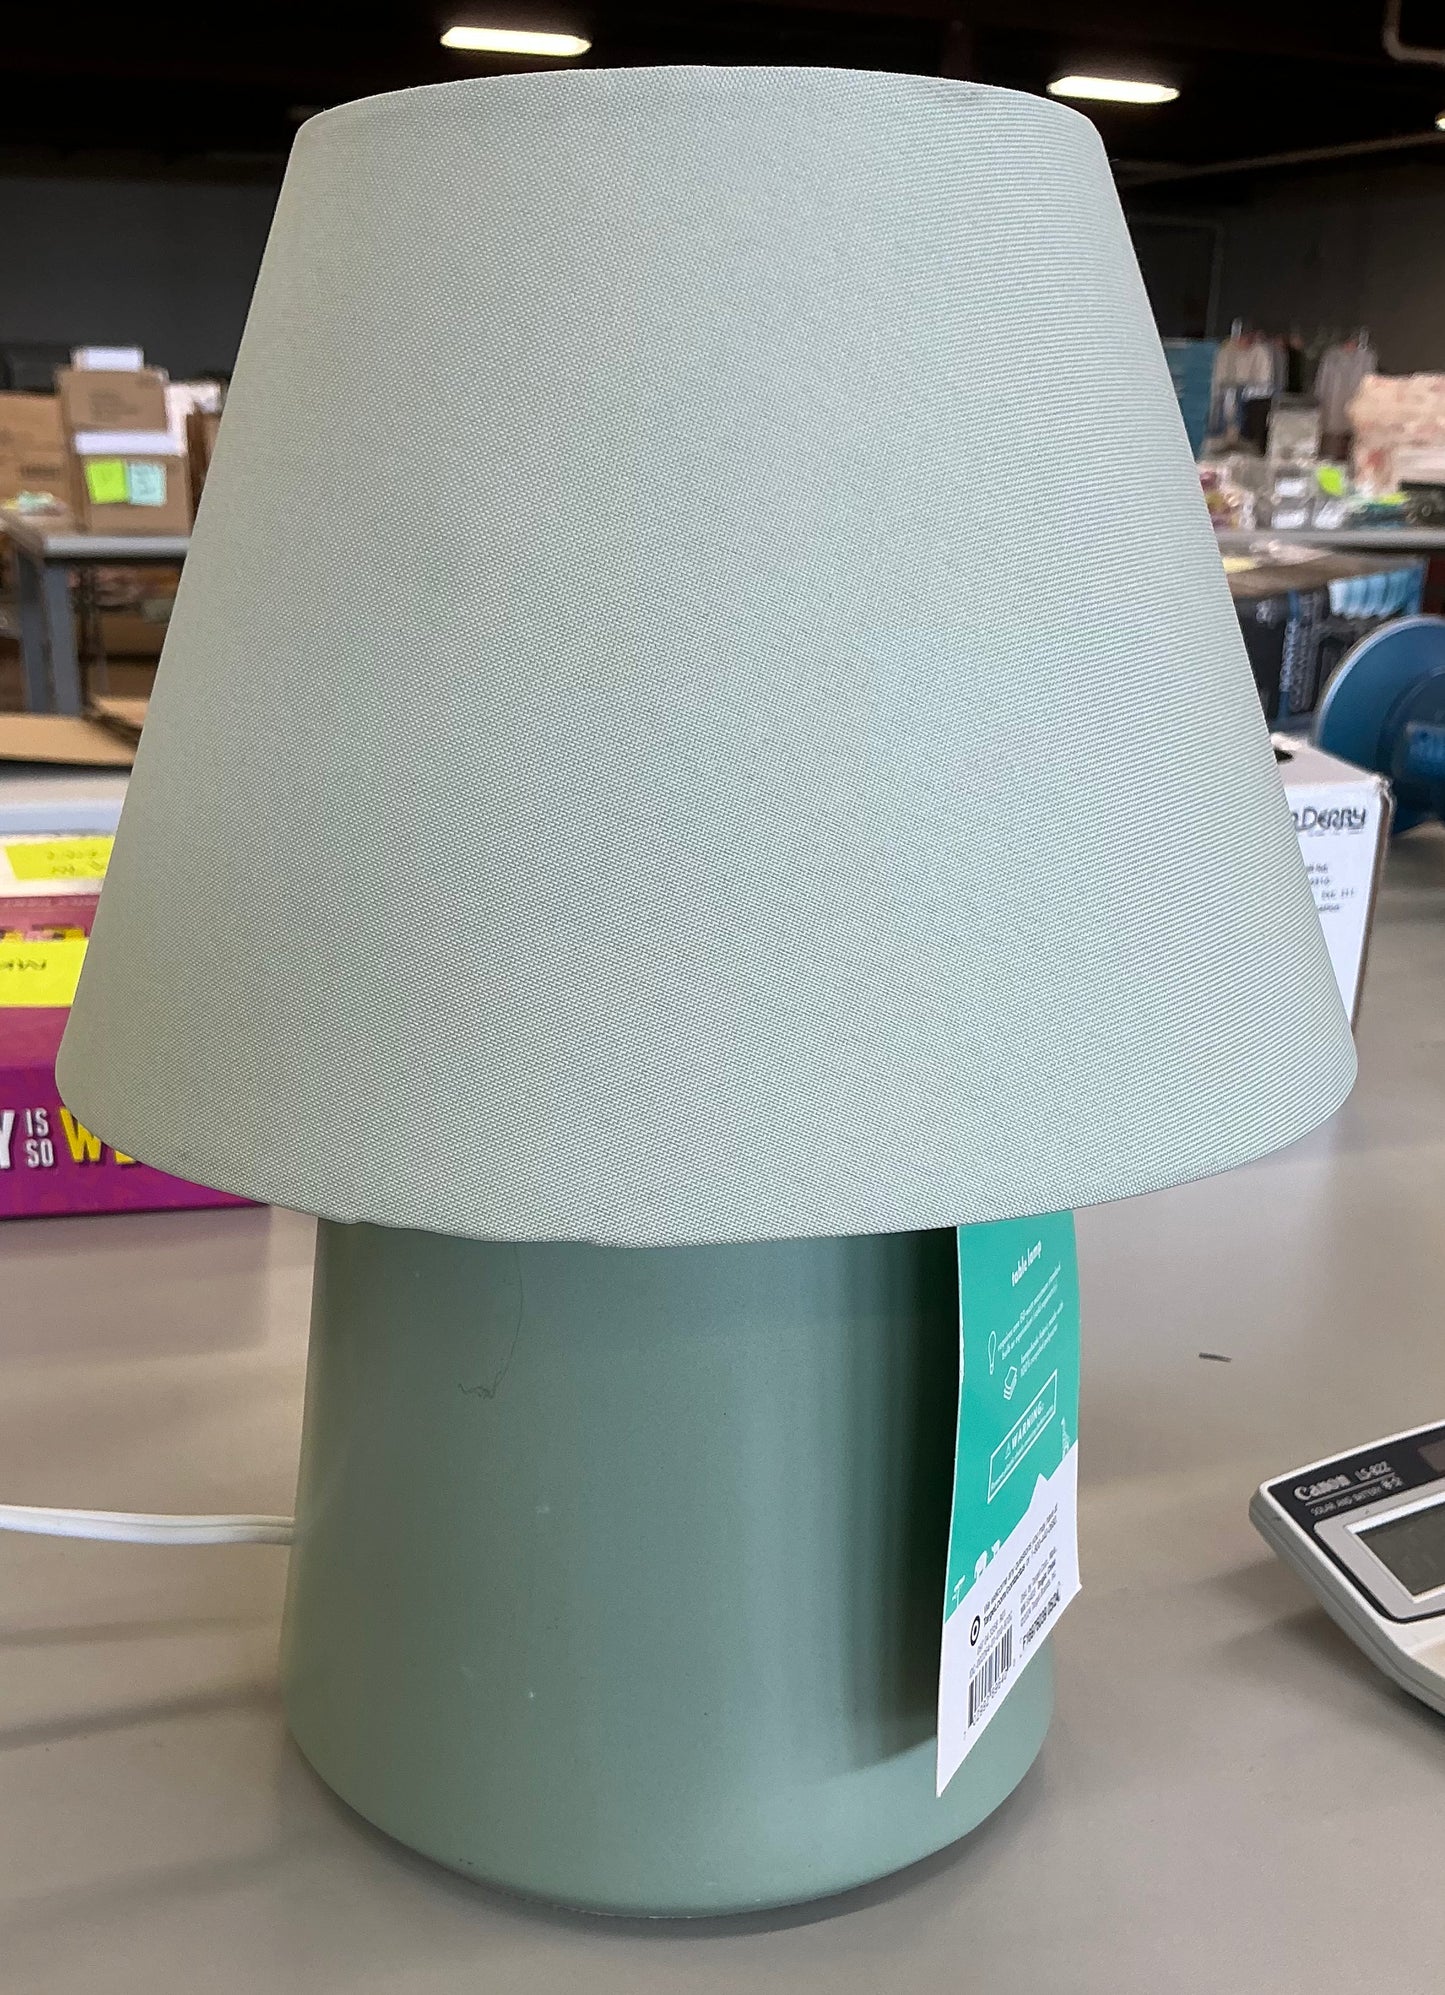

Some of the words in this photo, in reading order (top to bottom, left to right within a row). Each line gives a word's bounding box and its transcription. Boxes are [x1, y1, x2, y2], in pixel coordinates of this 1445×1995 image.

[25, 1107, 49, 1137] IS
[60, 1105, 137, 1164] W
[26, 1138, 55, 1168] SO
[1011, 1256, 1028, 1287] table
[1027, 1240, 1042, 1267] lamp
[1294, 1474, 1351, 1500] Canon
